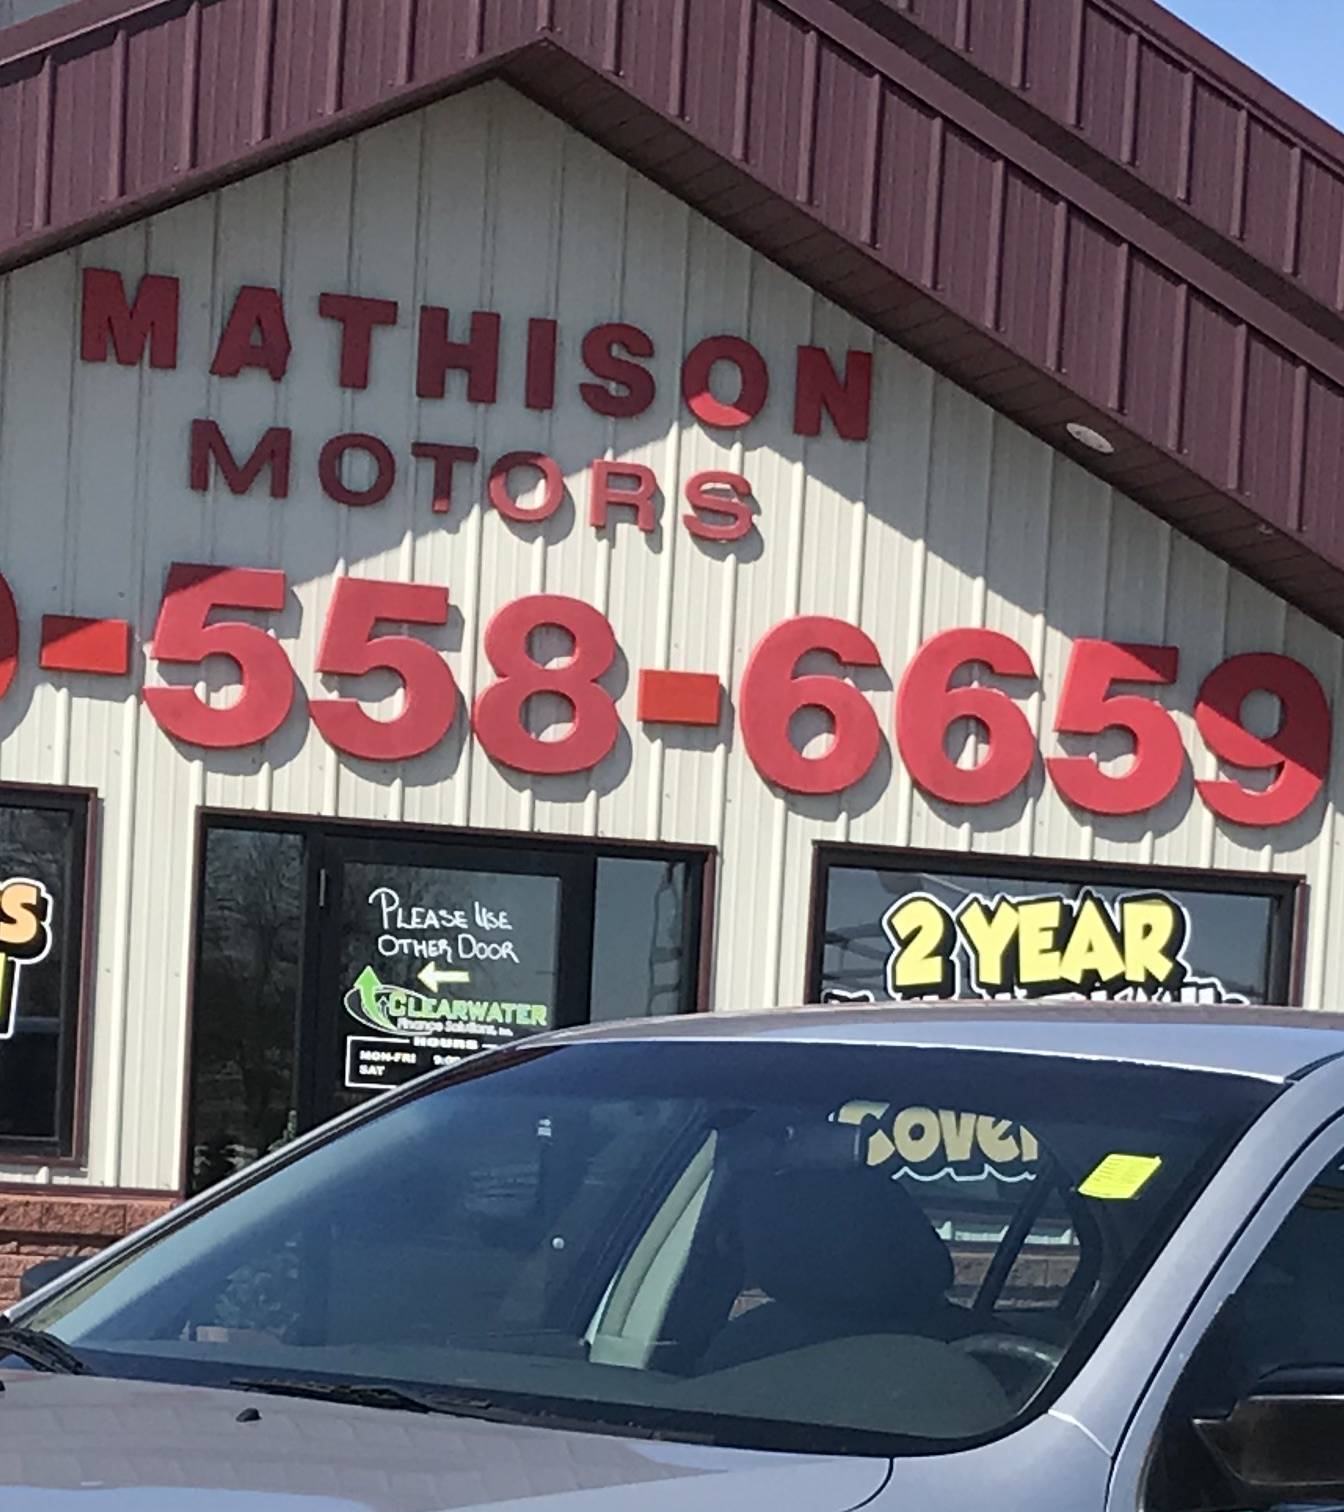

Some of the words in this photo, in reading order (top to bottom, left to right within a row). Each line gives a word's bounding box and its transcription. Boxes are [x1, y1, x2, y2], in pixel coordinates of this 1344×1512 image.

[81, 267, 874, 441] MATHISON
[189, 417, 757, 542] MOTORS
[368, 887, 468, 931] PLEASE
[474, 901, 512, 930] USE
[378, 934, 453, 963] OTHER
[458, 933, 520, 963] DOOR
[890, 896, 946, 988] 2
[958, 893, 1178, 987] YEAR
[388, 991, 548, 1026] CLEARWATER
[359, 1050, 417, 1064] MON-FRI
[413, 1036, 478, 1050] HOURS
[359, 1064, 385, 1076] SAT
